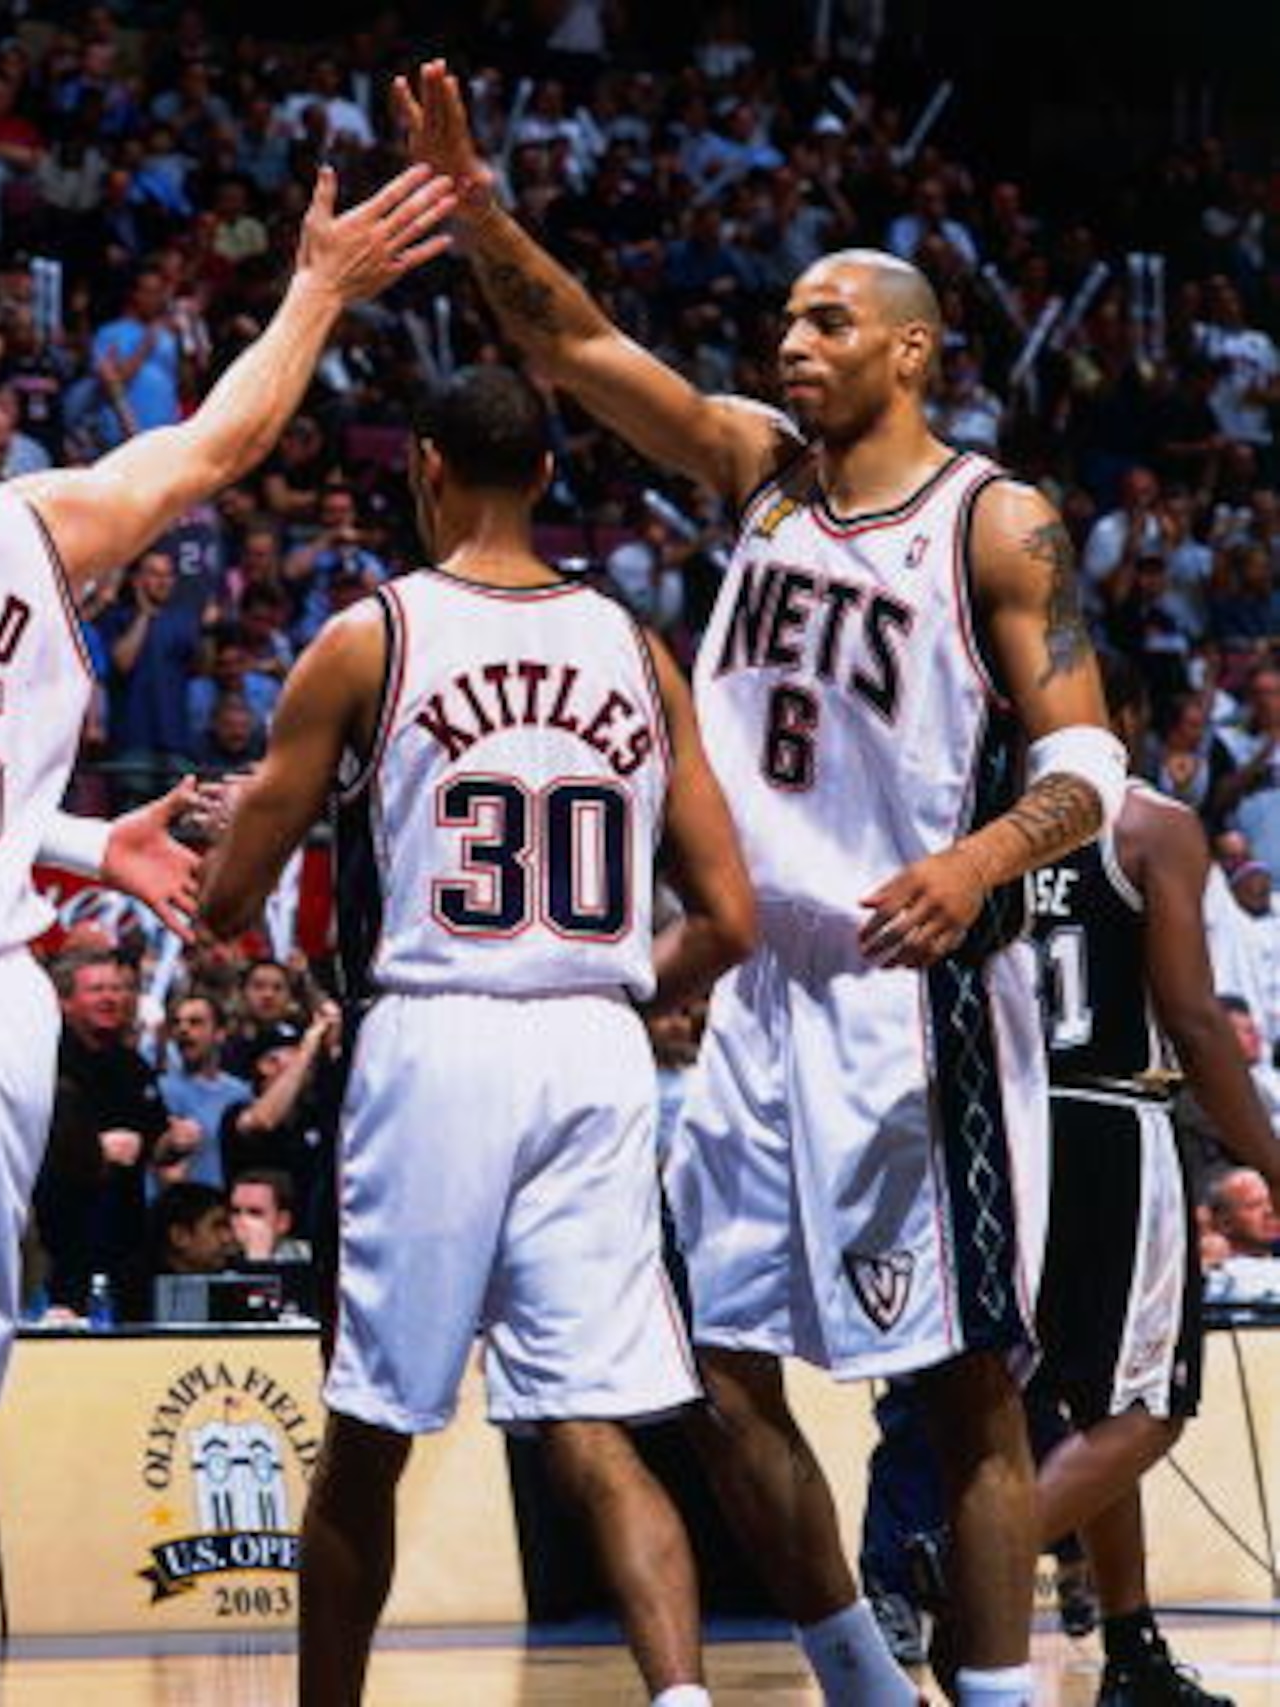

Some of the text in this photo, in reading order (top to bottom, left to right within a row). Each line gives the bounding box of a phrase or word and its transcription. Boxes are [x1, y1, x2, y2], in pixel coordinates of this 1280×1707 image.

[712, 560, 917, 729] NETS
[415, 660, 652, 775] KITTLES
[762, 682, 819, 793] 6
[431, 771, 634, 943] 30
[1024, 868, 1080, 916] SE
[144, 1362, 320, 1490] OLYMPIA FIELD
[163, 1536, 300, 1576] U.S. OPE
[216, 1587, 292, 1616] 2003
